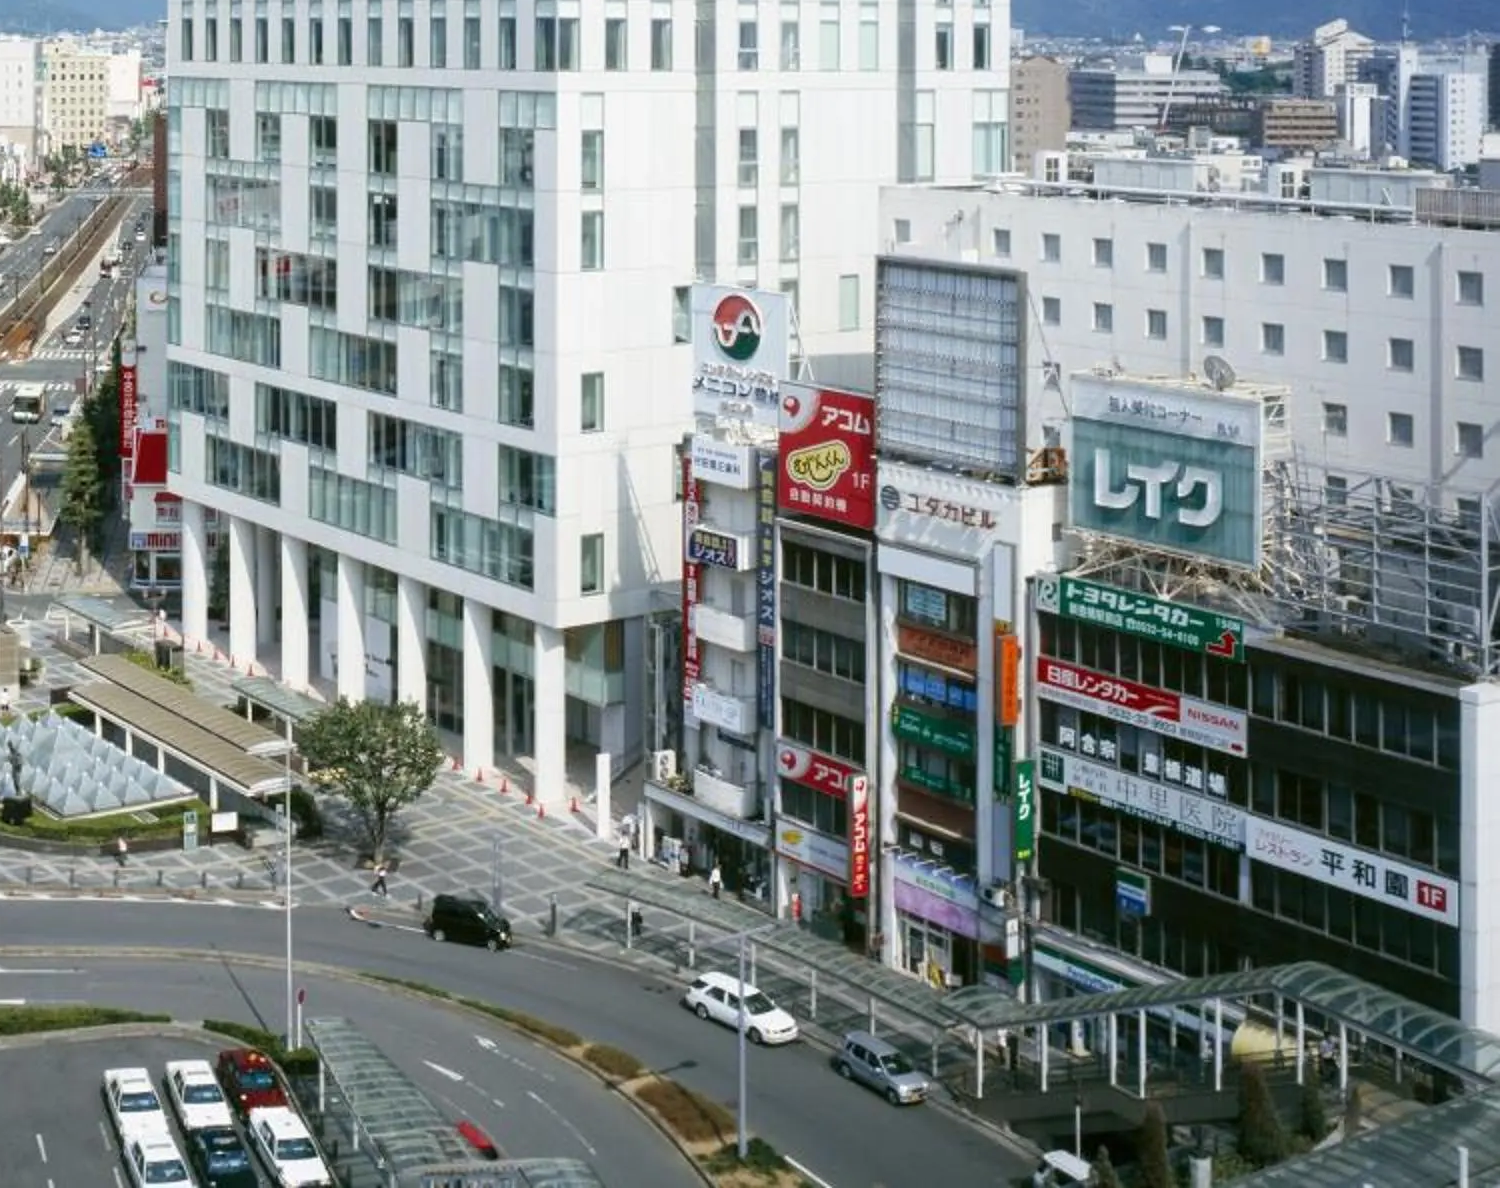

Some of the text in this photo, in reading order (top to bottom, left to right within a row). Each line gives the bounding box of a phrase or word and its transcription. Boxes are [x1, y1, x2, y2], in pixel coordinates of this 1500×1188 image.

[821, 404, 871, 436] アコム
[851, 471, 872, 490] 1F
[1094, 447, 1223, 528] レイク
[906, 492, 997, 530] ユタカビル
[1066, 581, 1205, 628] トヨタレンタカー
[1046, 664, 1140, 702] 日産レンタカー
[1187, 707, 1240, 732] NISSAN
[1017, 772, 1030, 821] レイク
[1116, 775, 1238, 839] 中里医院
[853, 812, 866, 853] アコム
[1254, 838, 1314, 867] レストラン
[1419, 885, 1444, 907] 1F
